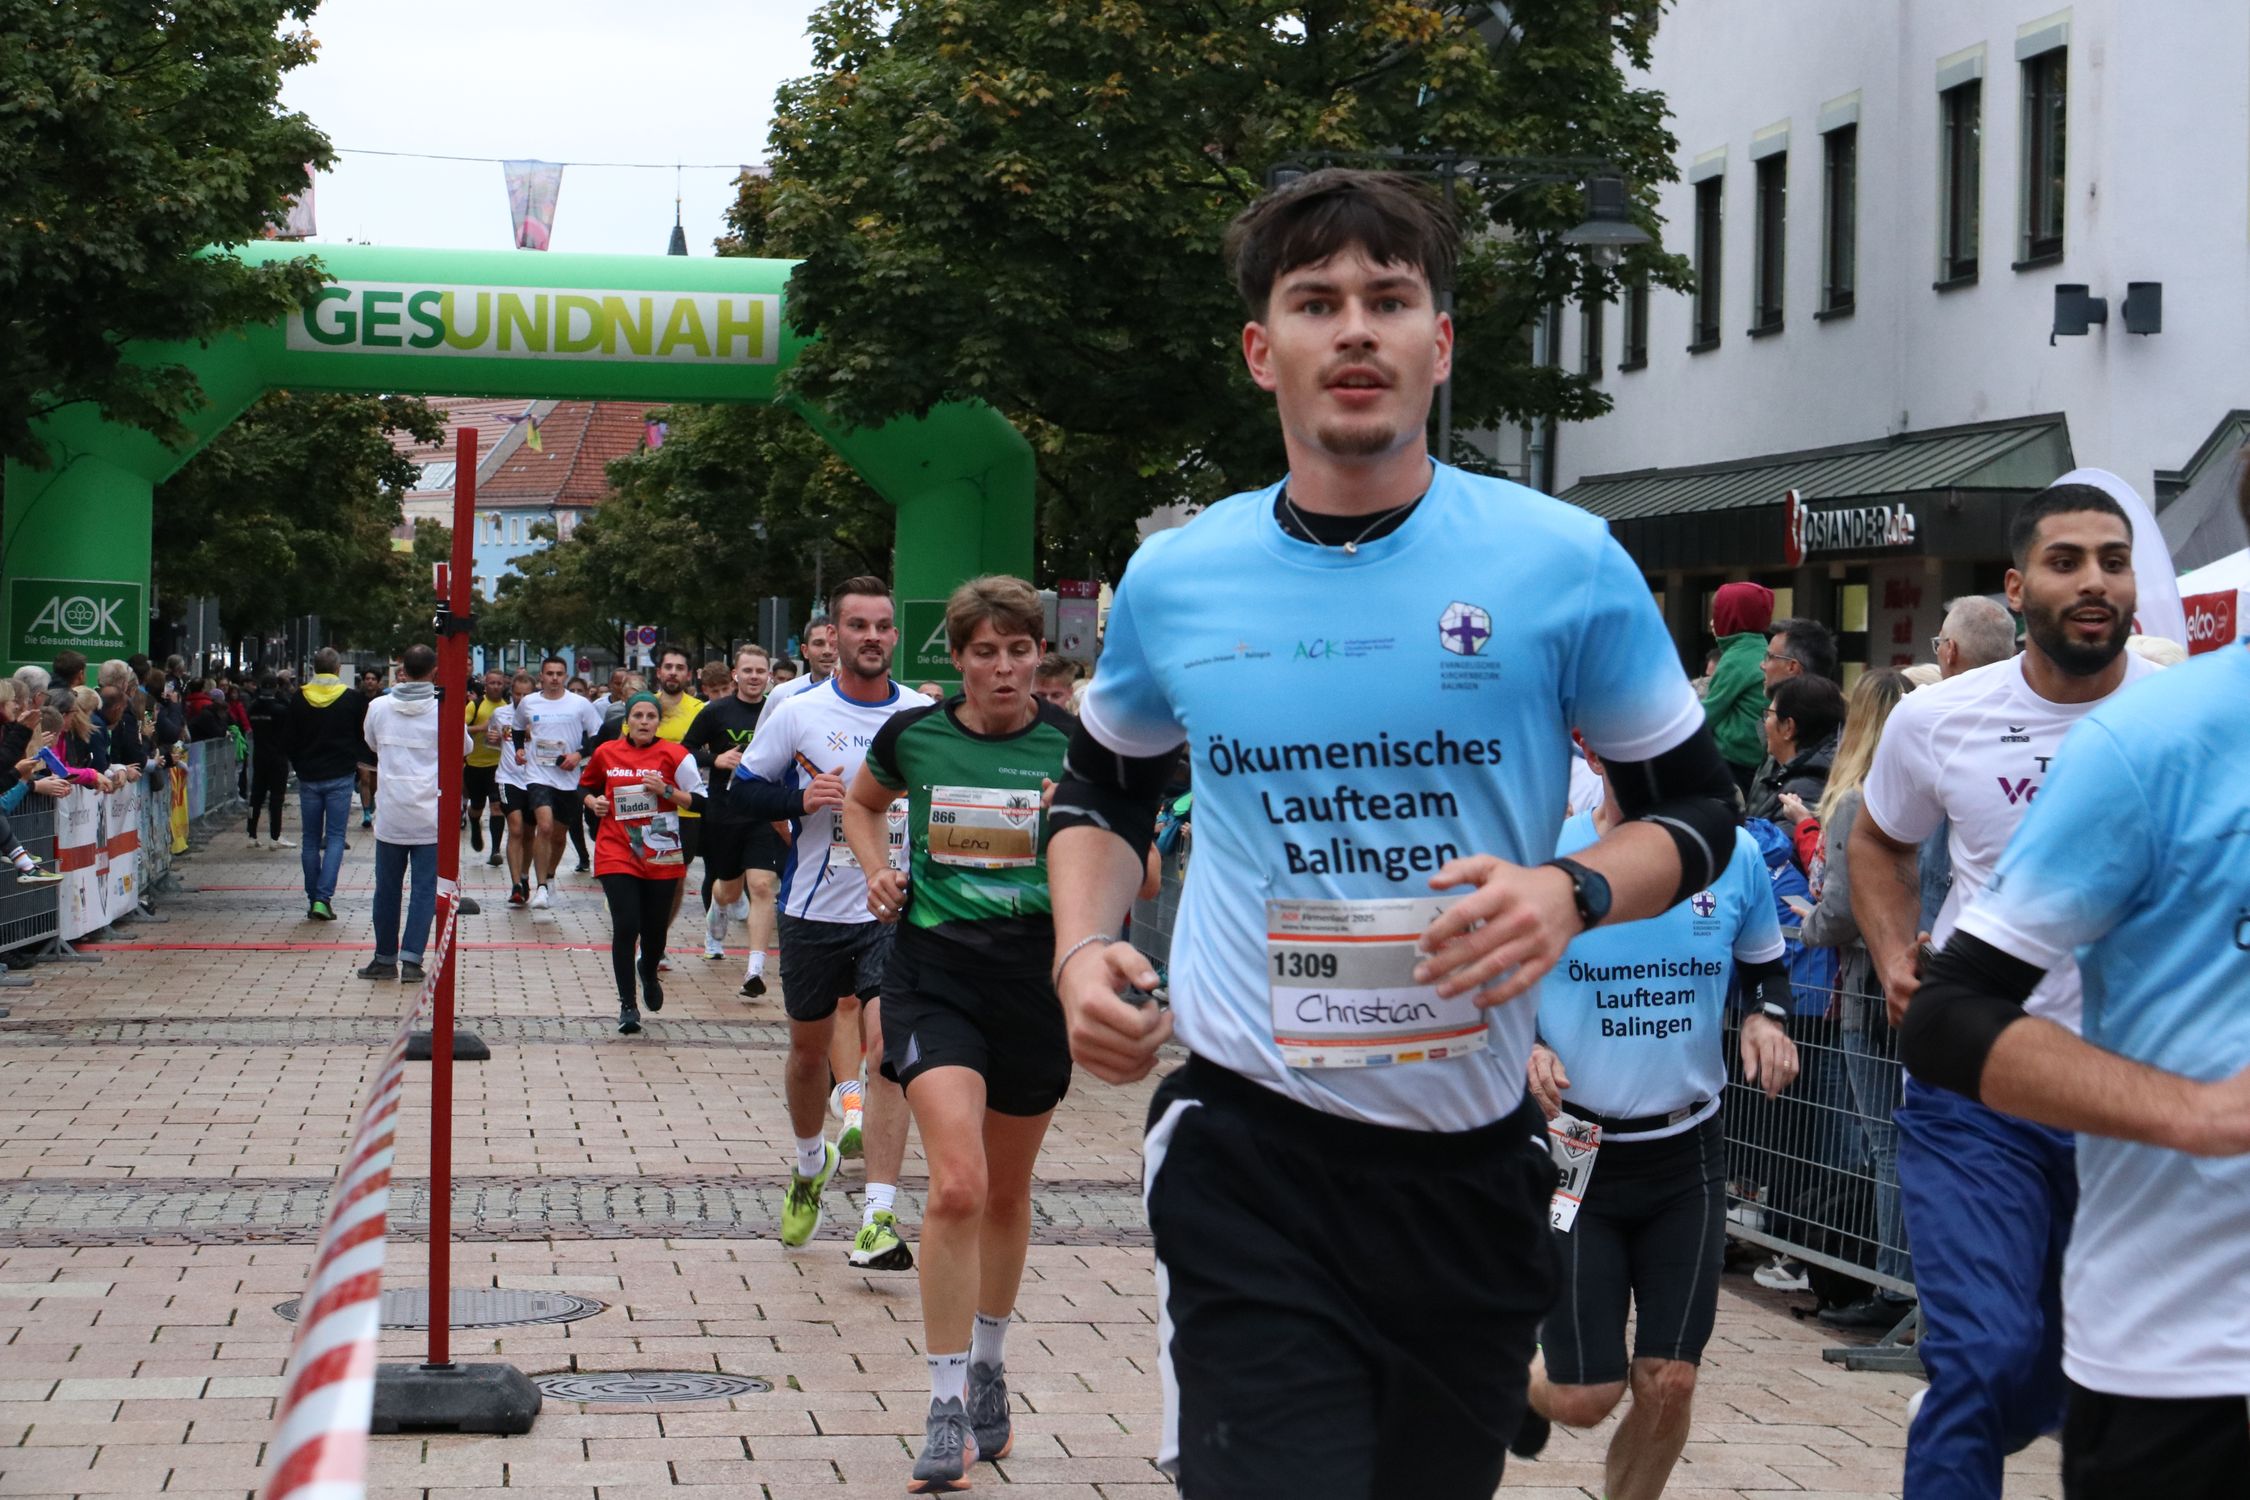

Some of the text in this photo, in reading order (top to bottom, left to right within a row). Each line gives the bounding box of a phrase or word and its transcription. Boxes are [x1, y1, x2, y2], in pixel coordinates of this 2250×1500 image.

[303, 286, 765, 359] GESUNDNAH
[27, 595, 125, 636] AOK
[24, 634, 38, 645] Die
[1292, 638, 1342, 662] ACK
[2000, 735, 2031, 743] erima
[1208, 729, 1503, 777] Ökumenisches
[620, 802, 651, 813] Nadda
[932, 810, 957, 824] 866
[1260, 784, 1459, 825] Laufteam
[947, 826, 990, 850] Lena
[1283, 836, 1460, 883] Balingen
[1272, 951, 1339, 979] 1309
[1568, 957, 1722, 983] Ökumenisches
[1295, 993, 1437, 1026] Christian
[1596, 987, 1695, 1009] Laufteam
[1601, 1016, 1692, 1039] Balingen
